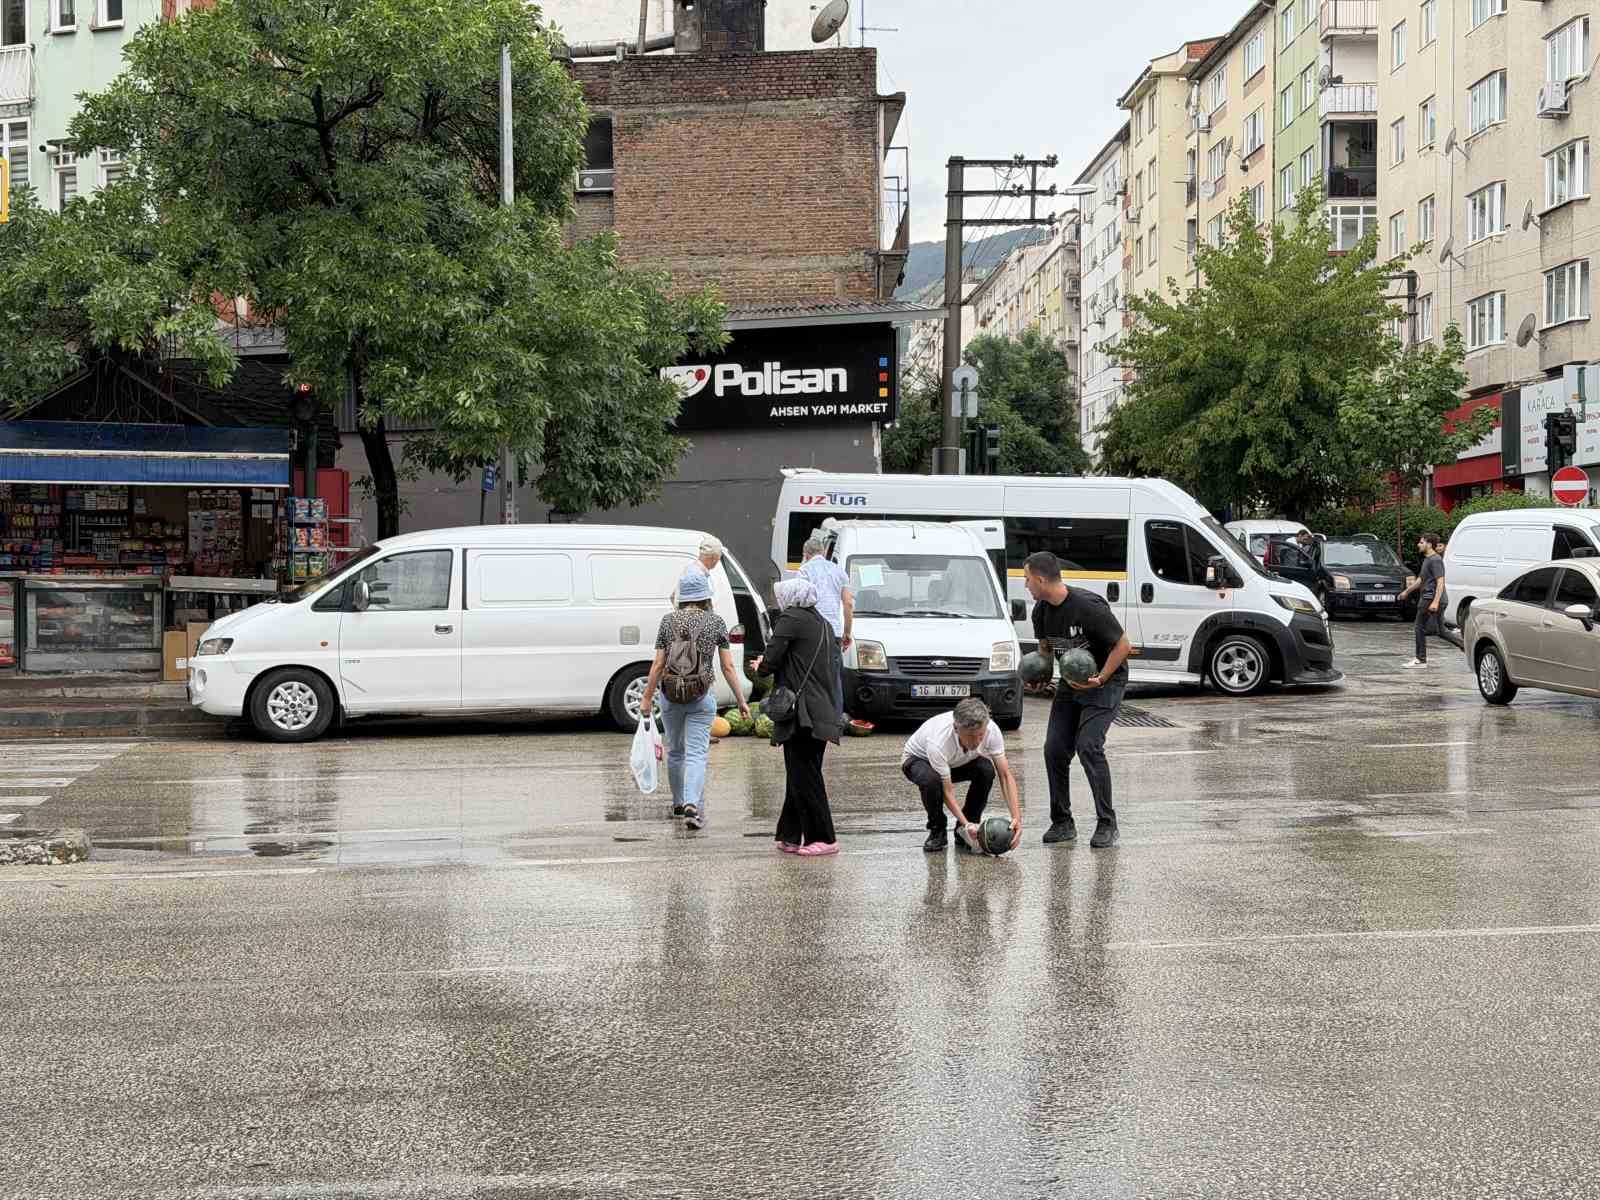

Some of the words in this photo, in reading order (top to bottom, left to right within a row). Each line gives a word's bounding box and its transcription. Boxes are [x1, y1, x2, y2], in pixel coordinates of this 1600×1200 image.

[714, 361, 848, 397] Polisan
[770, 406, 809, 417] AHSEN
[811, 405, 837, 416] YAPI
[840, 403, 888, 415] MARKET
